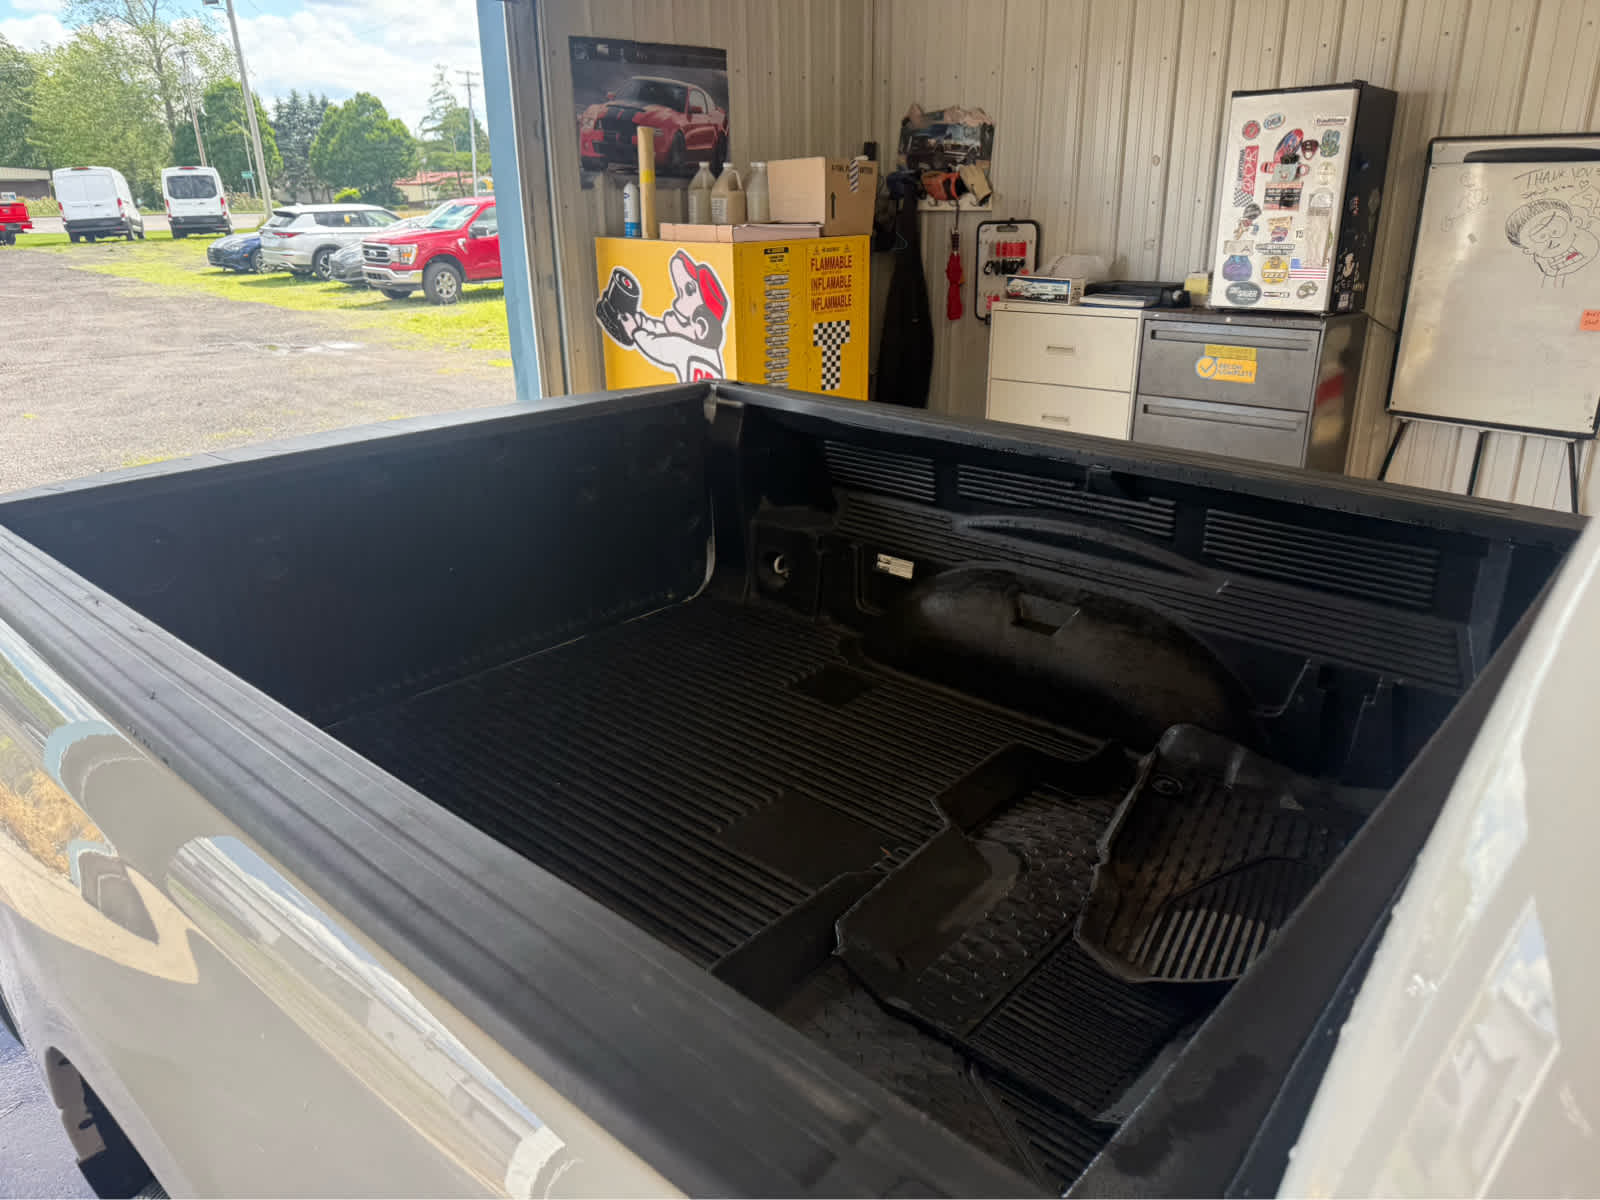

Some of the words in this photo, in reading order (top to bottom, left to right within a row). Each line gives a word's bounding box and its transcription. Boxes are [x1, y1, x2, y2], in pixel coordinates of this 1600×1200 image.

[1514, 168, 1565, 187] THANK
[811, 255, 853, 272] FLAMMABLE
[811, 275, 852, 291] INFLAMABLE
[811, 294, 852, 311] INFLAMMABLE
